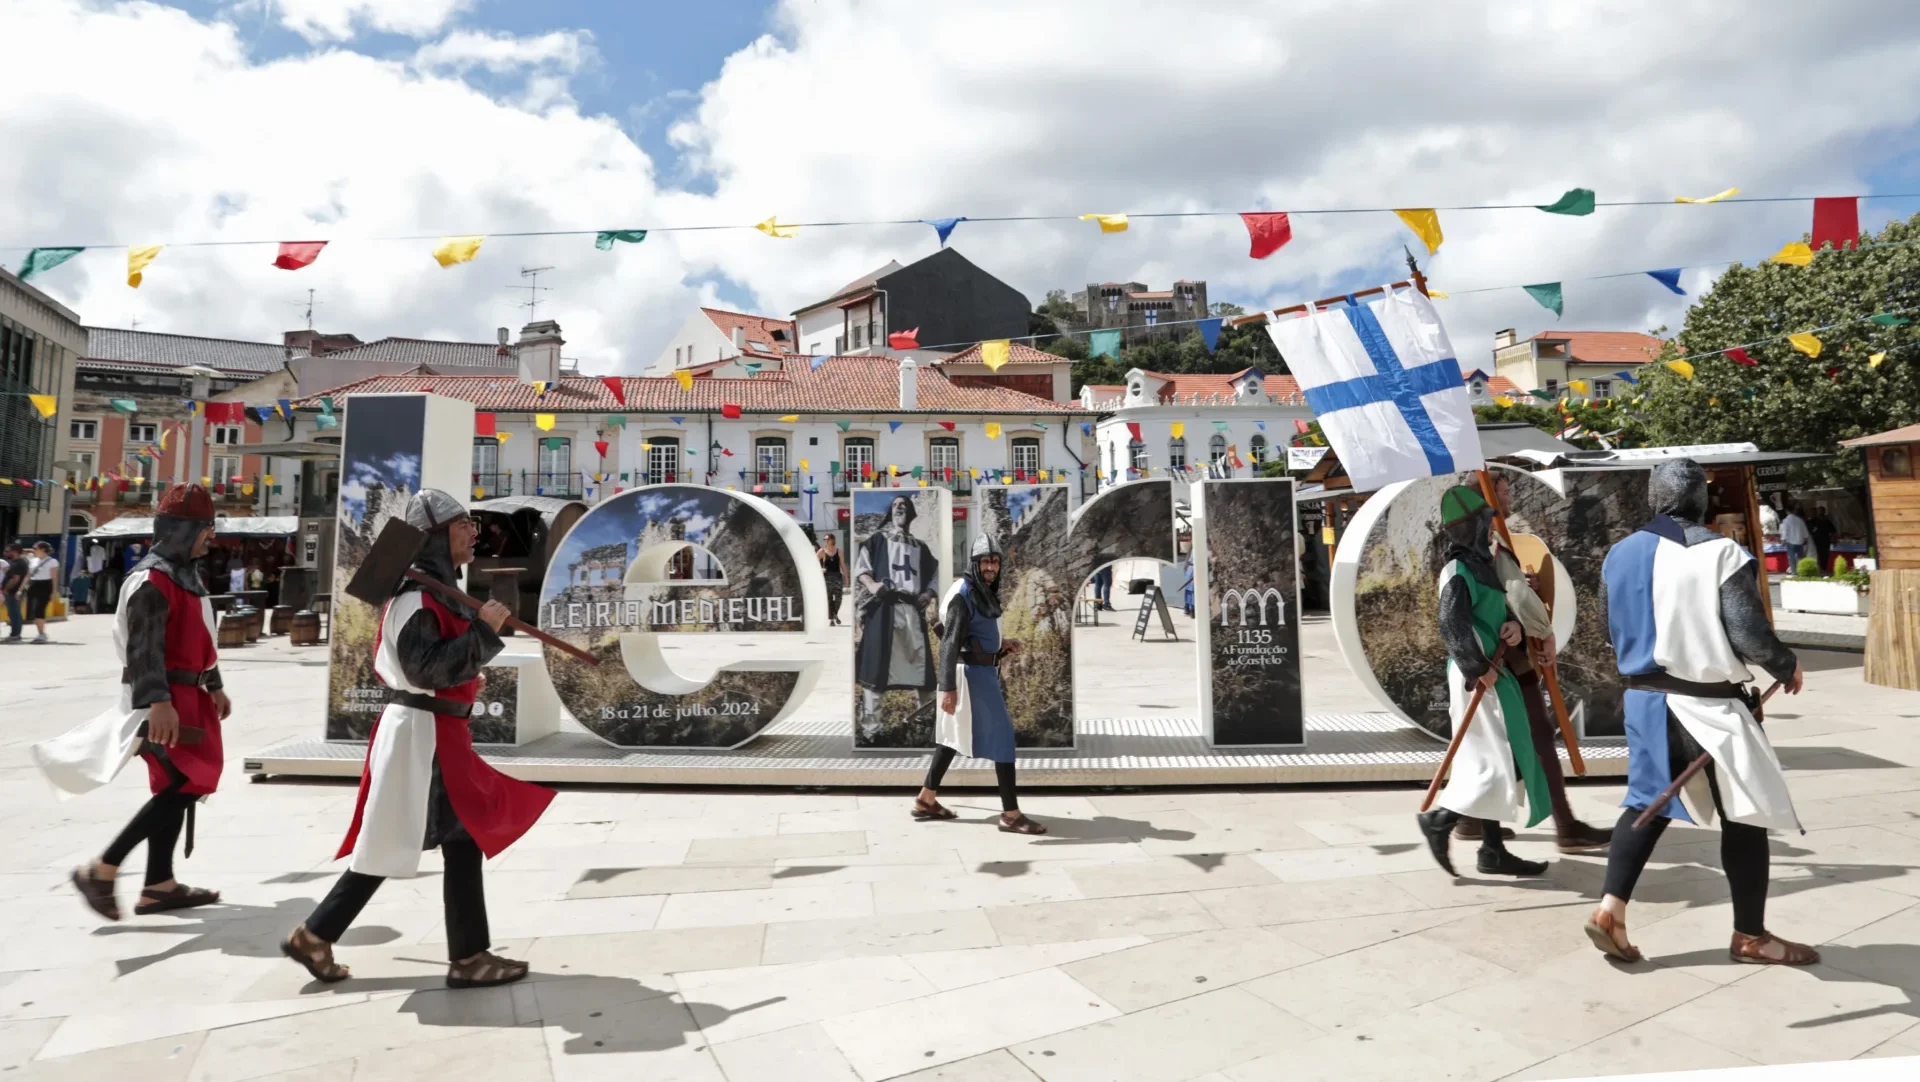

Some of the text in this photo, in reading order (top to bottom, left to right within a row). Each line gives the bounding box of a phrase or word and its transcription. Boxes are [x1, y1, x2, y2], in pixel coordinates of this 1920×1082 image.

[550, 596, 802, 628] LEIRIA MEDIEVAL
[1236, 629, 1272, 644] 1135
[601, 702, 760, 721] 18 a 21 de julho 2024
